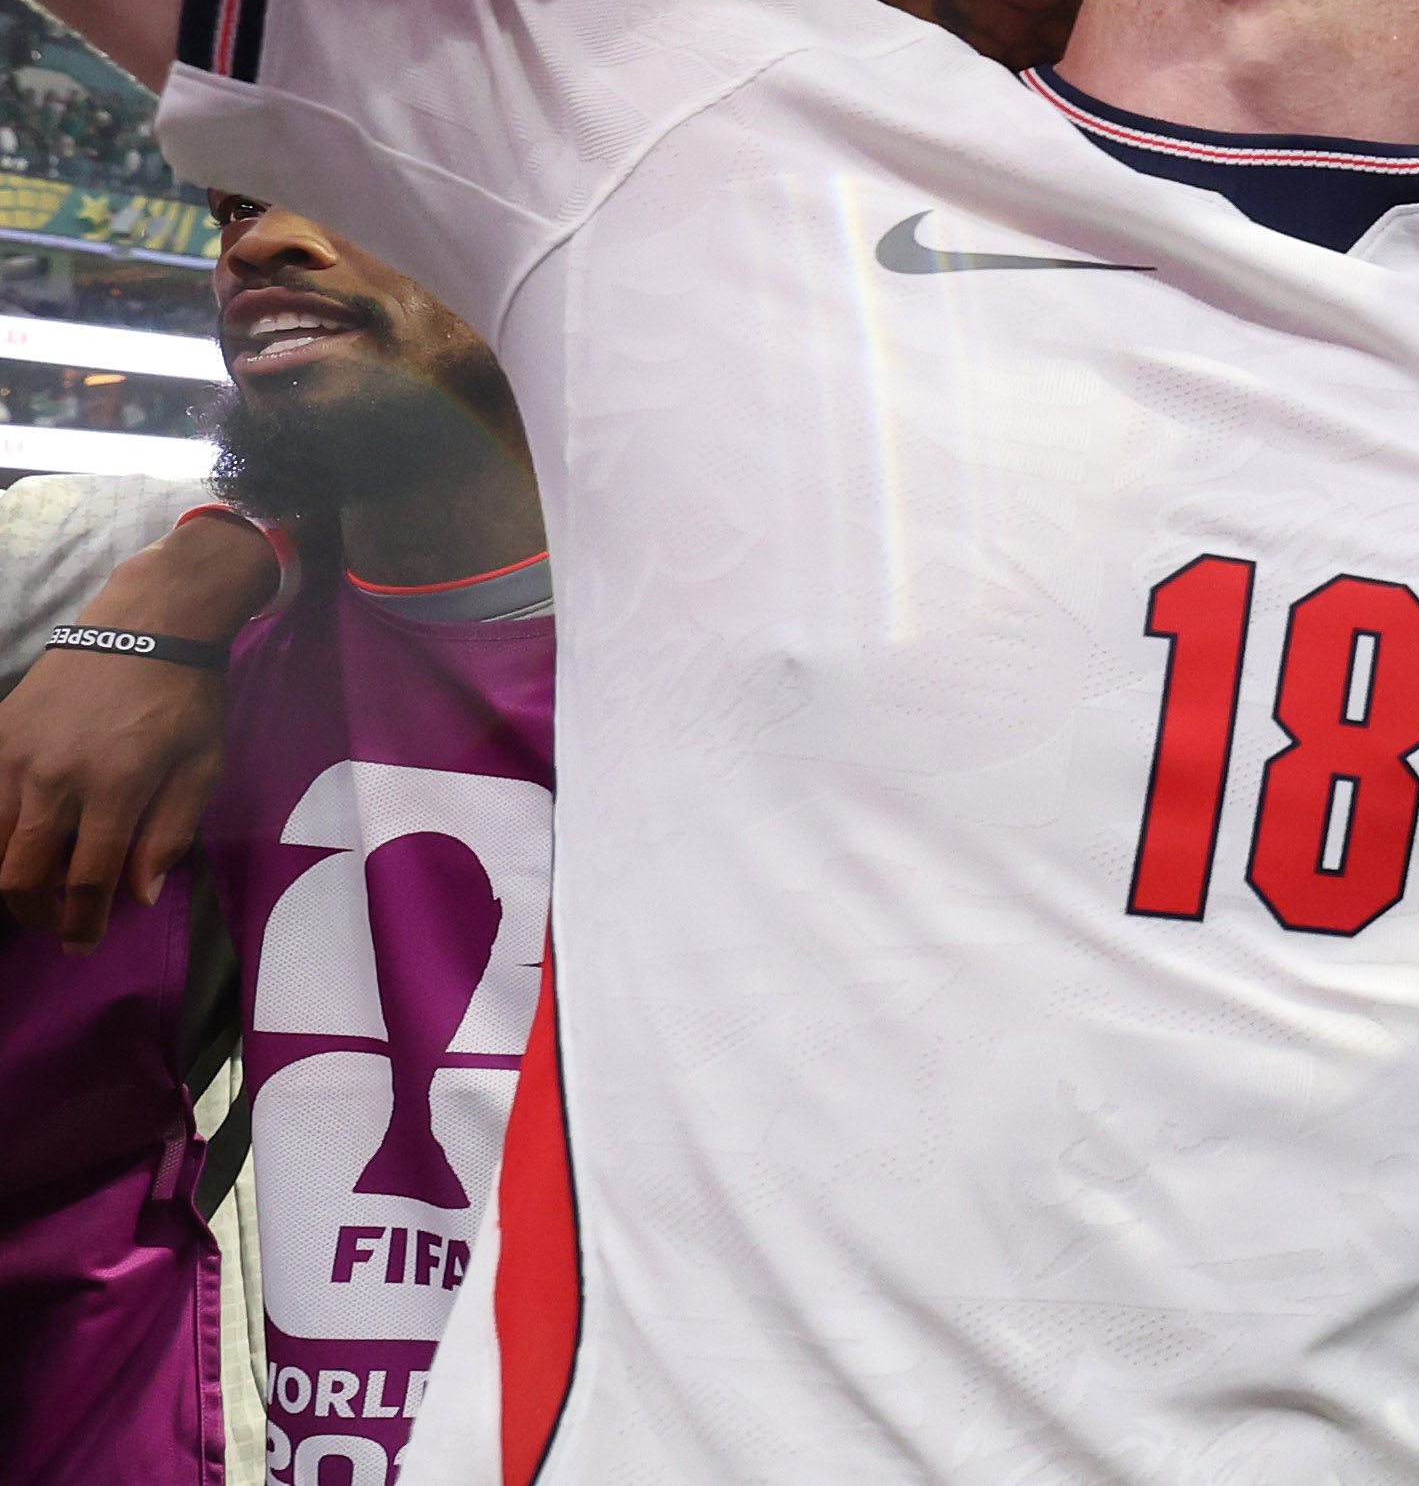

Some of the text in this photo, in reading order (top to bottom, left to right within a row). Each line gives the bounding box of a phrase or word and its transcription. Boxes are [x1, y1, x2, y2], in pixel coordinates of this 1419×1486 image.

[46, 628, 156, 653] GODSPEE
[330, 1225, 471, 1291] FIFA
[267, 1361, 432, 1418] ORL
